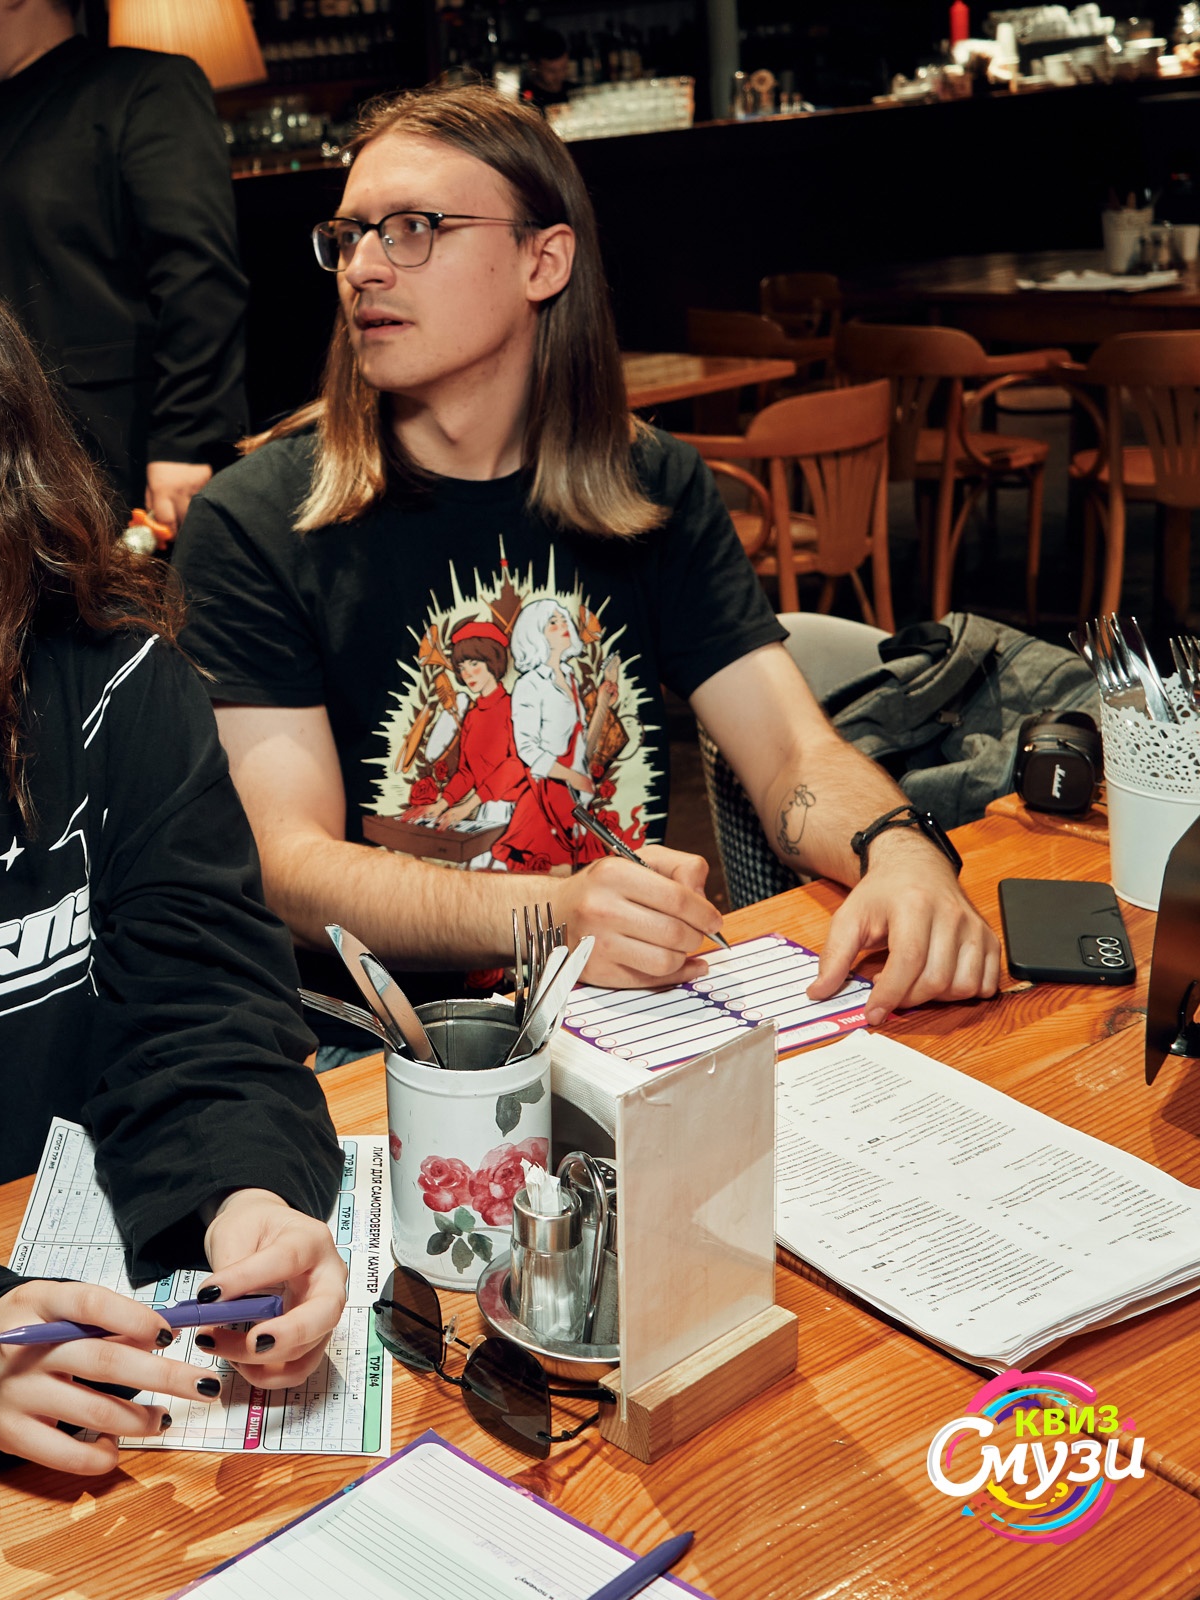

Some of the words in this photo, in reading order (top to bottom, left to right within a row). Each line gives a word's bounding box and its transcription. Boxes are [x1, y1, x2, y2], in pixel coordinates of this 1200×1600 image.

[345, 1154, 354, 1166] ТУР
[373, 1146, 383, 1168] ЛИСТ
[371, 1169, 383, 1184] ДЛЯ
[342, 1206, 351, 1219] ТУР
[369, 1185, 382, 1249] САМОПРОВЕРКИ
[340, 1220, 350, 1231] №2
[367, 1256, 380, 1294] КАУНТЕР
[369, 1356, 380, 1371] ТУР
[369, 1373, 380, 1387] №4
[246, 1416, 260, 1439] БЛИЦ
